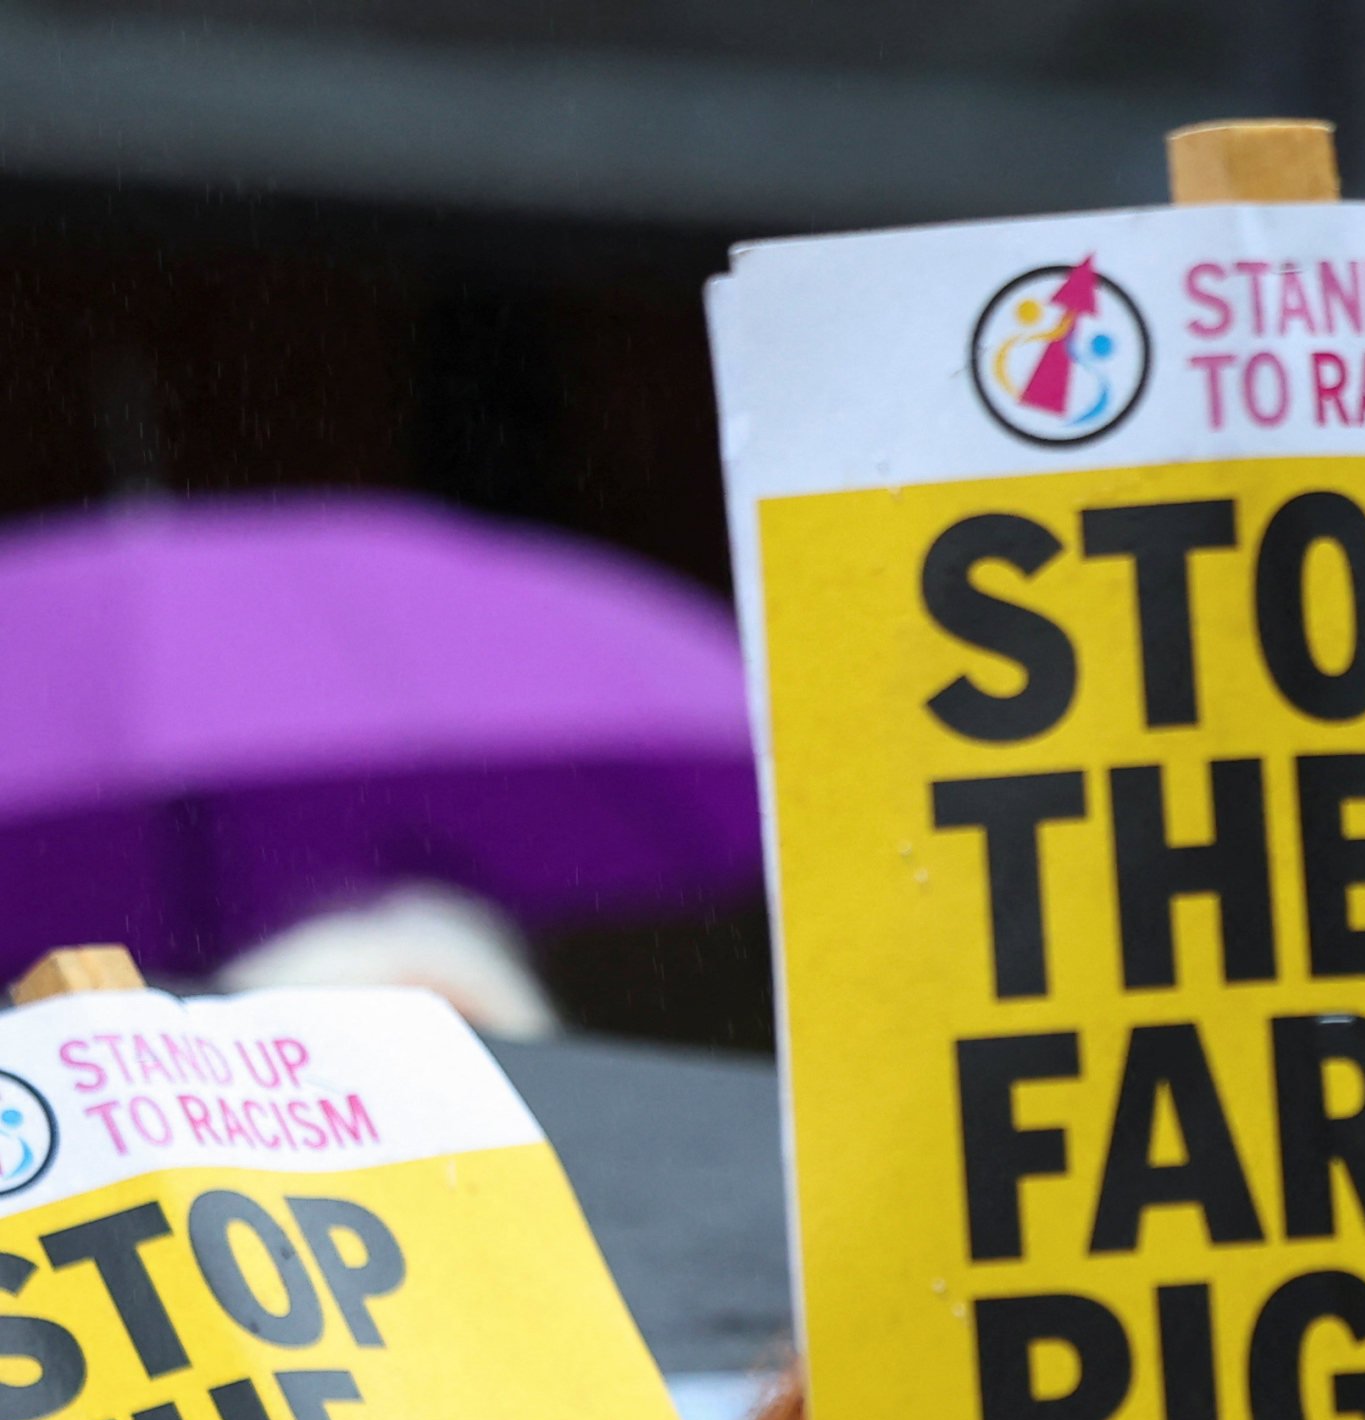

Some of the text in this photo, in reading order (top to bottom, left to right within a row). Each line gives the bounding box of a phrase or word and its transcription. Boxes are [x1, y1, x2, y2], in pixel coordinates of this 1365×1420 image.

[1190, 352, 1293, 431] TO
[59, 1033, 310, 1092] STAND UP
[84, 1093, 381, 1156] TO RACISM
